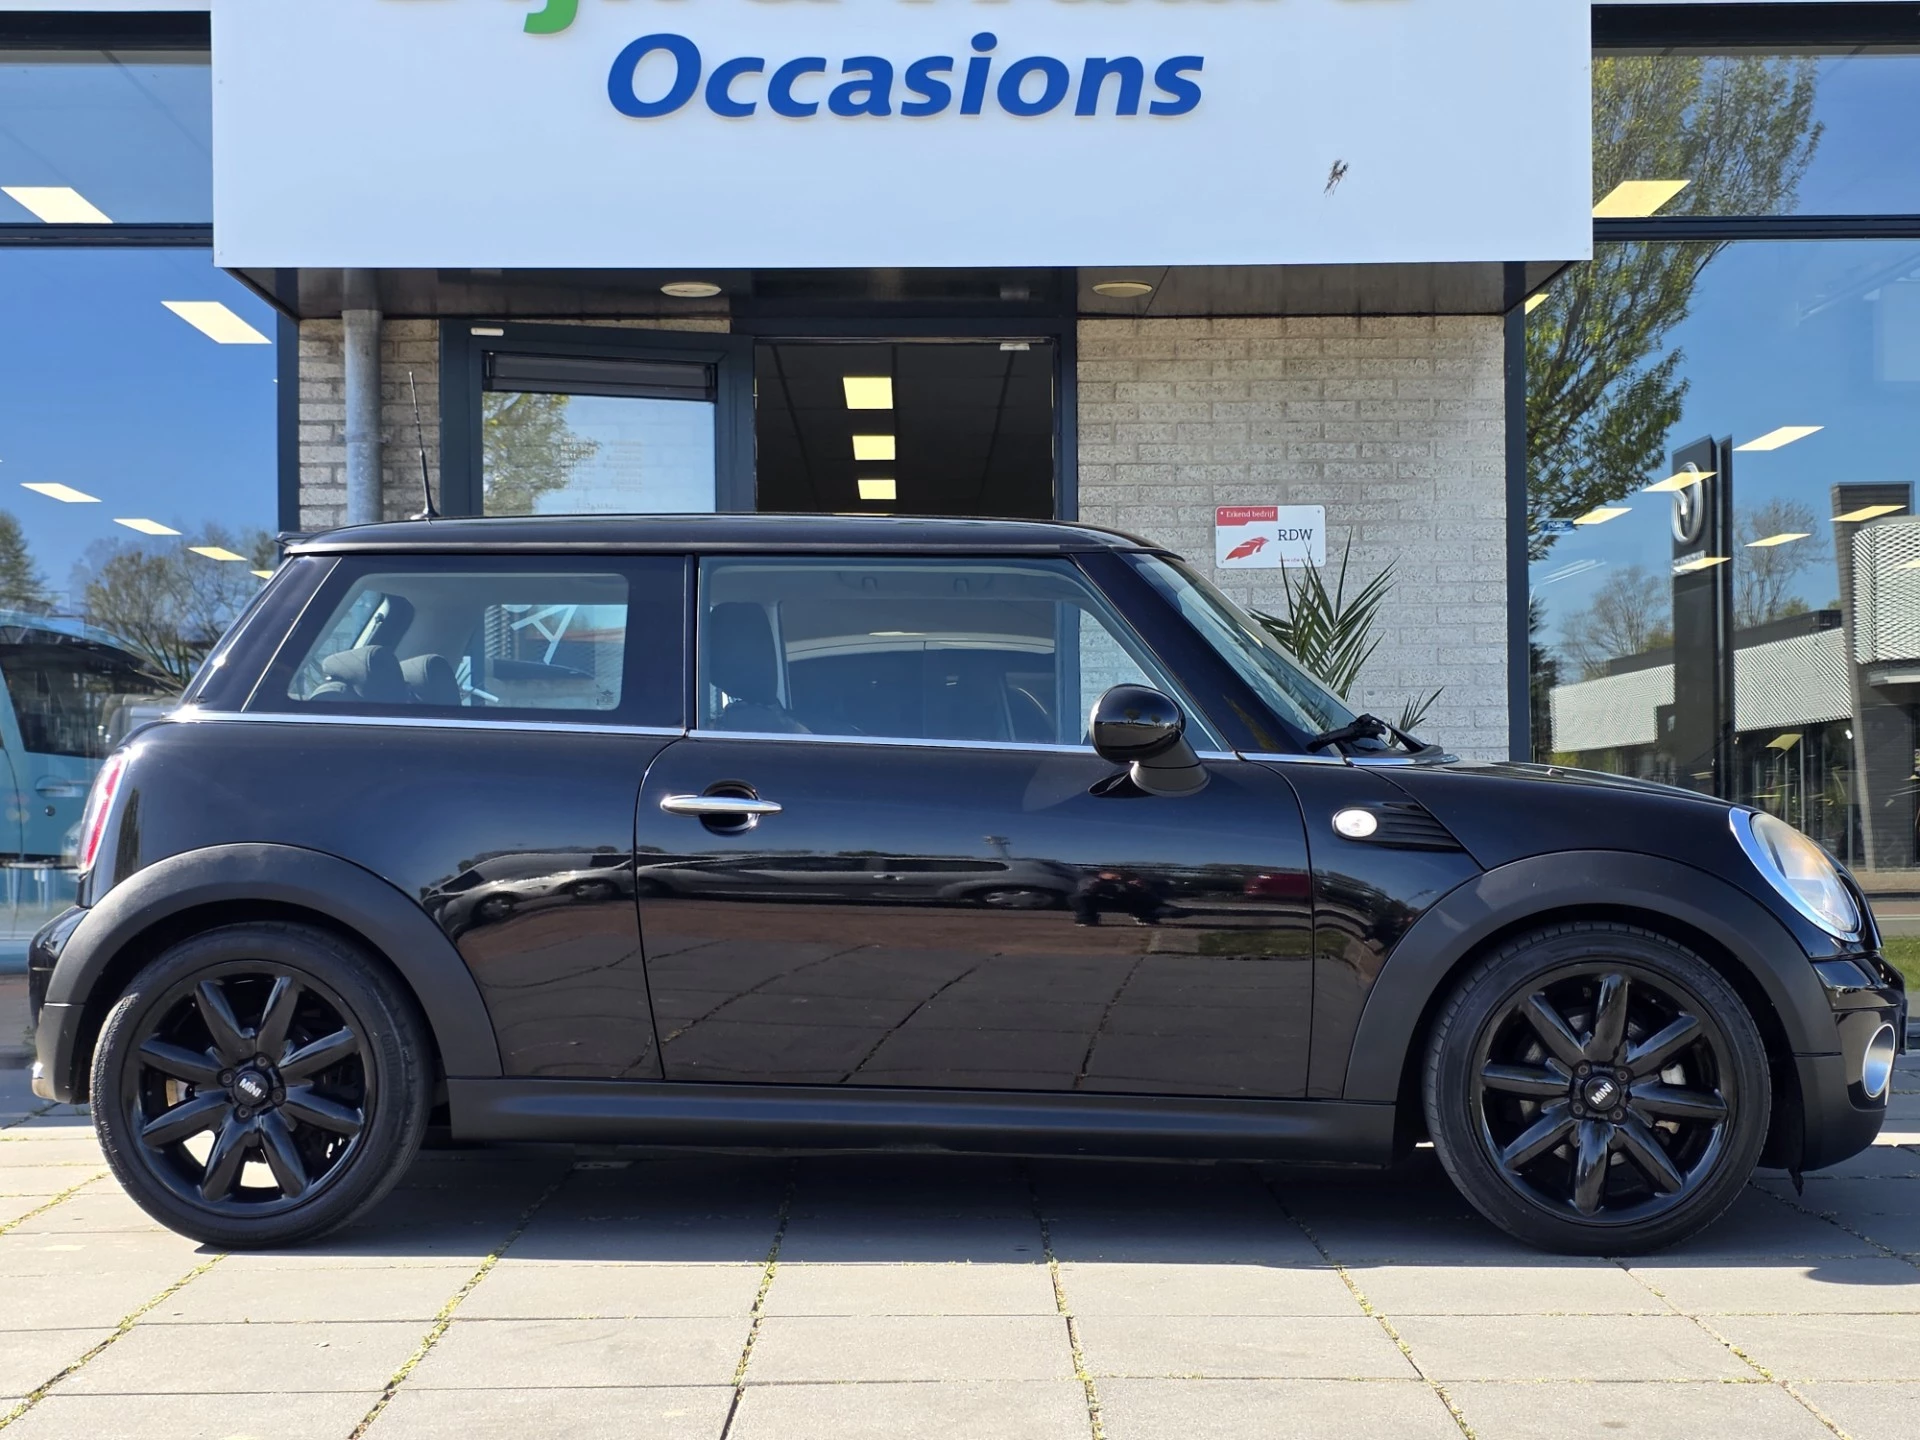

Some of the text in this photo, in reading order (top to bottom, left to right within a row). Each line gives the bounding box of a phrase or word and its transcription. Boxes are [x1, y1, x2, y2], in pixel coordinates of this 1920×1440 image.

[607, 32, 1203, 118] Occasions
[1226, 509, 1275, 519] Erkend bedrijf
[1278, 529, 1313, 541] RDW
[239, 1078, 262, 1097] MINI
[1591, 1082, 1613, 1104] MINI
